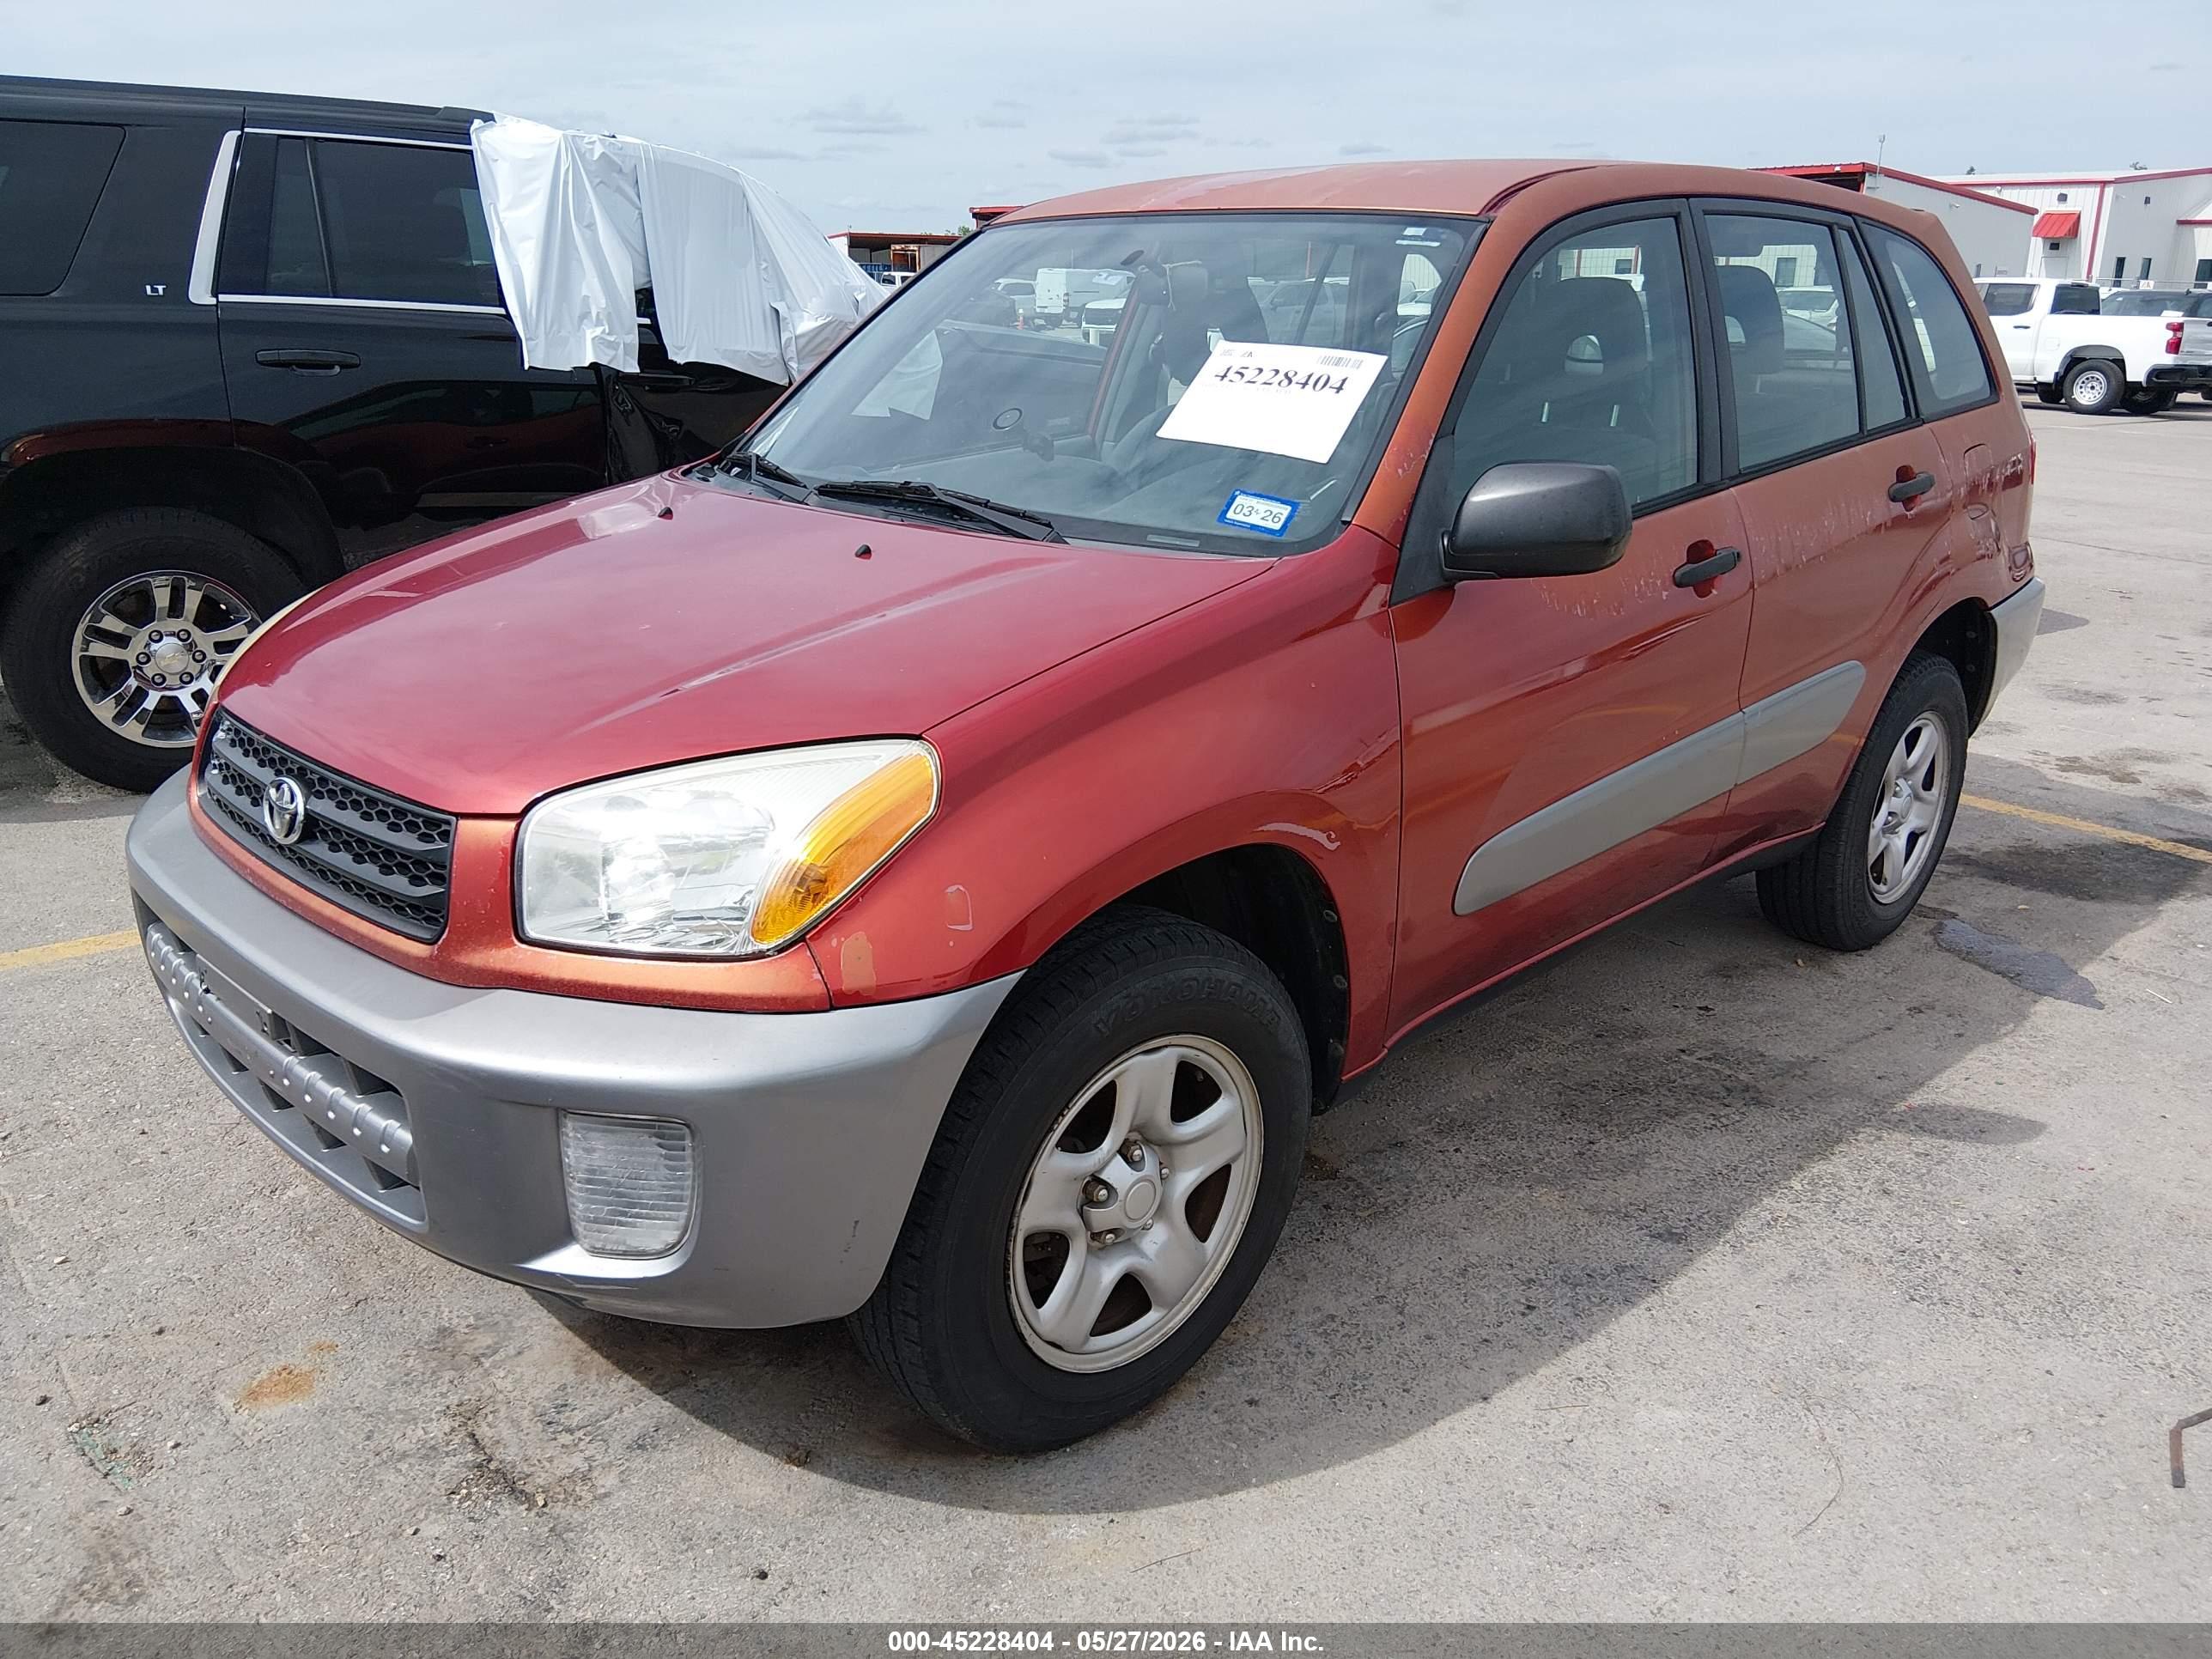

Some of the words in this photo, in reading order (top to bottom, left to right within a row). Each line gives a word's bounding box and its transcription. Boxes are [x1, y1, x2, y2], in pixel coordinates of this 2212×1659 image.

[145, 284, 167, 296] LT
[1214, 365, 1349, 394] 45228404
[1233, 503, 1255, 517] 03
[1260, 509, 1284, 524] 26
